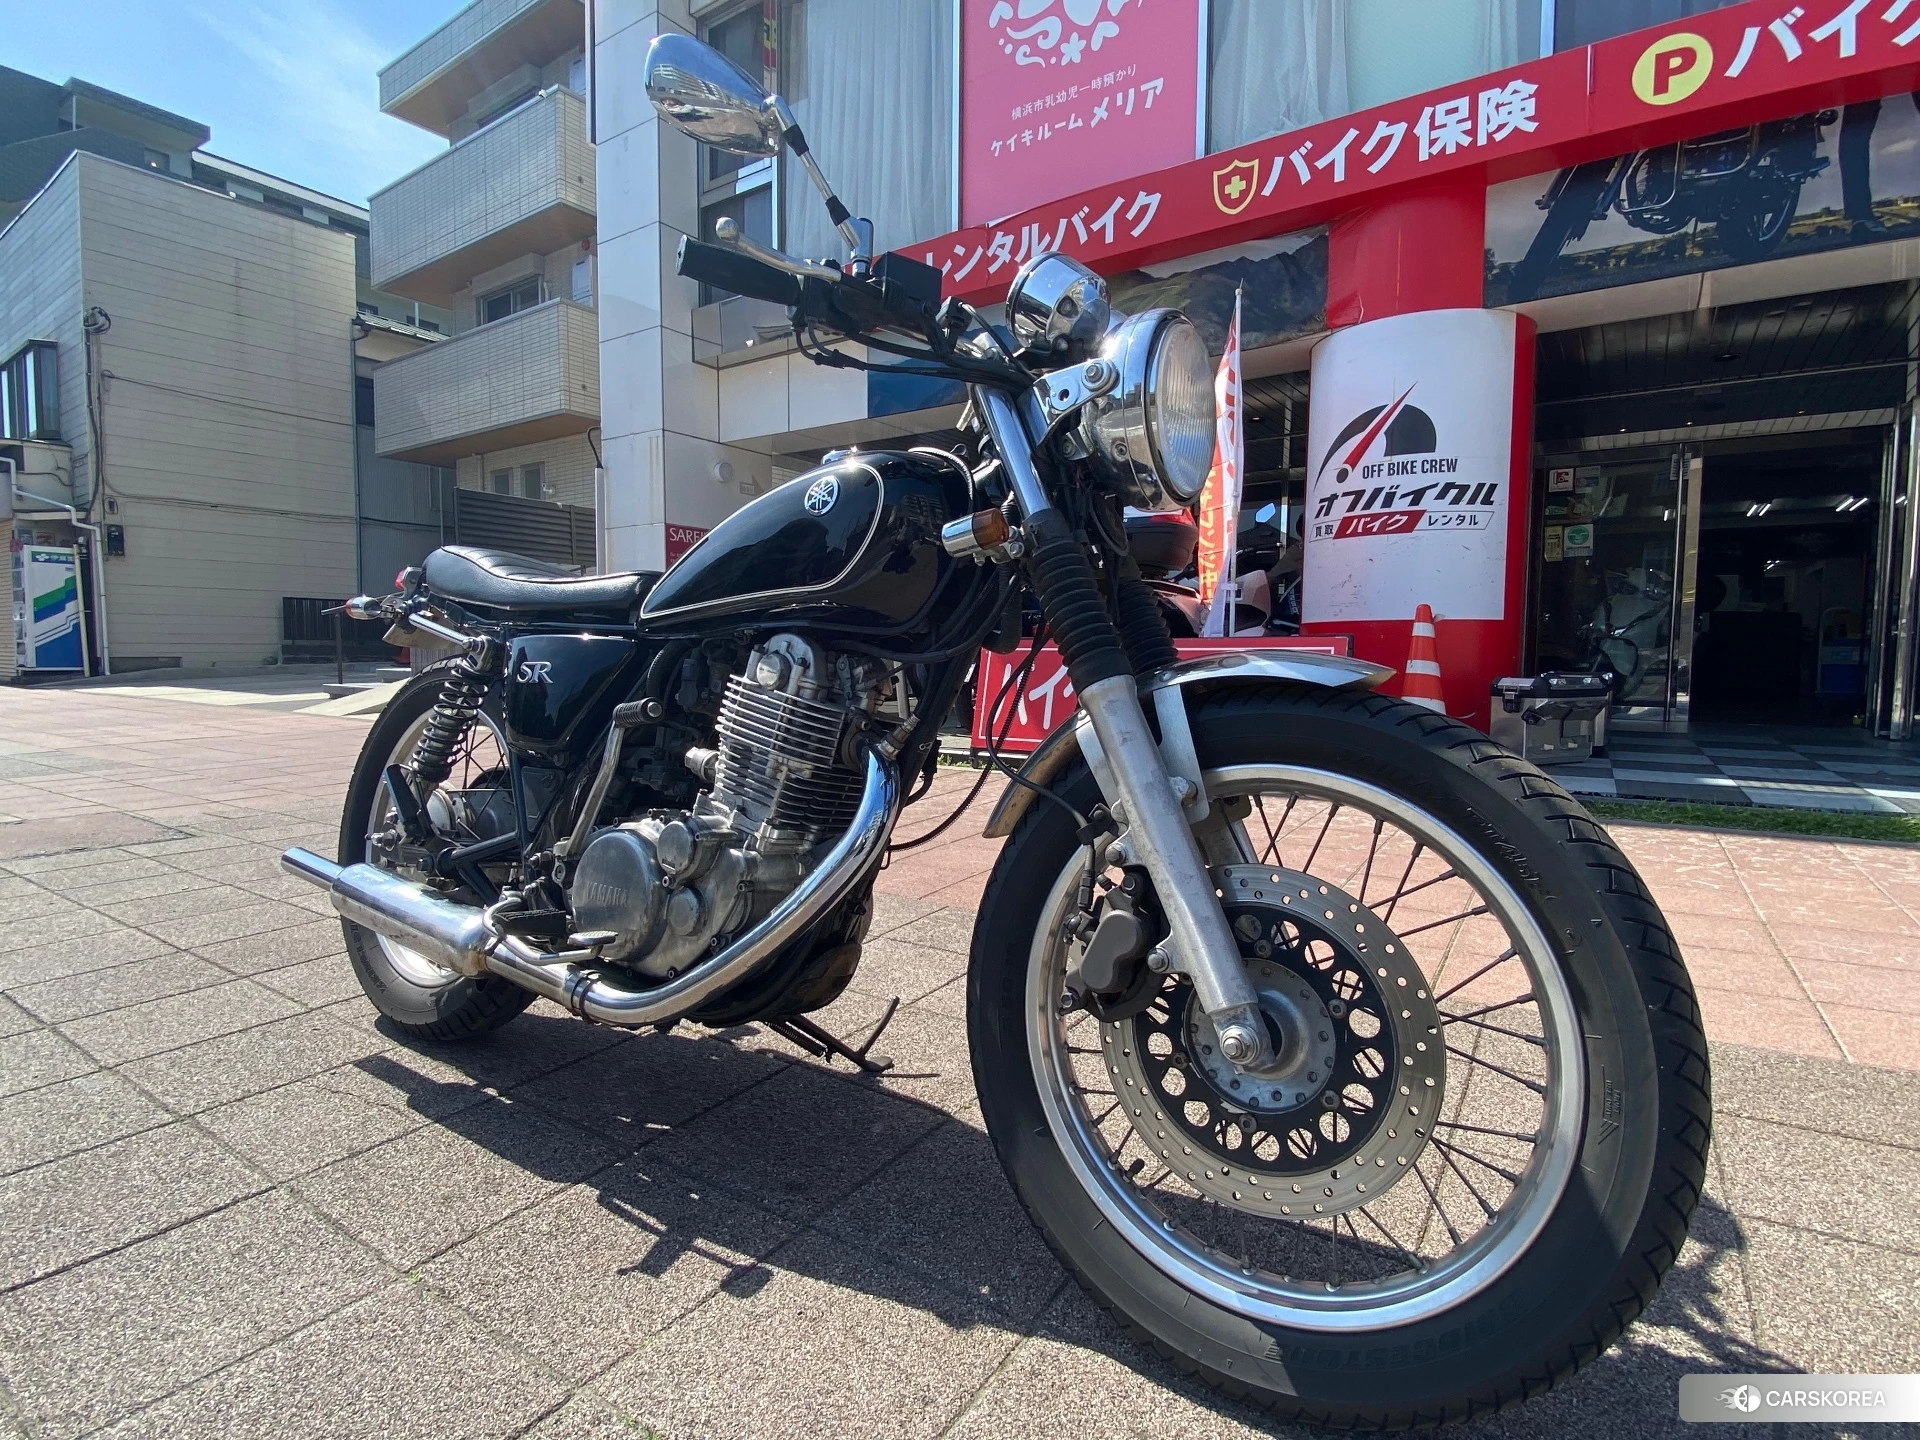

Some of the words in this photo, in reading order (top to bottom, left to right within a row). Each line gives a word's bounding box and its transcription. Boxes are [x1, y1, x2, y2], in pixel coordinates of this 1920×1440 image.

[1011, 64, 1136, 120] 横浜市乳幼児一時預かり
[990, 112, 1084, 157] ケイキルーム
[1090, 77, 1164, 128] メリア
[1260, 79, 1540, 197] バイク保険
[926, 190, 1162, 282] レンタルバイク
[1362, 463, 1385, 480] OFF
[1387, 460, 1417, 477] BIKE
[1421, 458, 1458, 474] CREW
[1314, 482, 1499, 519] オフバイクル
[1315, 524, 1334, 538] 買取
[1345, 514, 1409, 535] バイク
[1428, 514, 1479, 527] レンタル
[516, 661, 554, 684] SR
[993, 663, 1074, 730] バイ
[587, 881, 629, 908] YAMAHA
